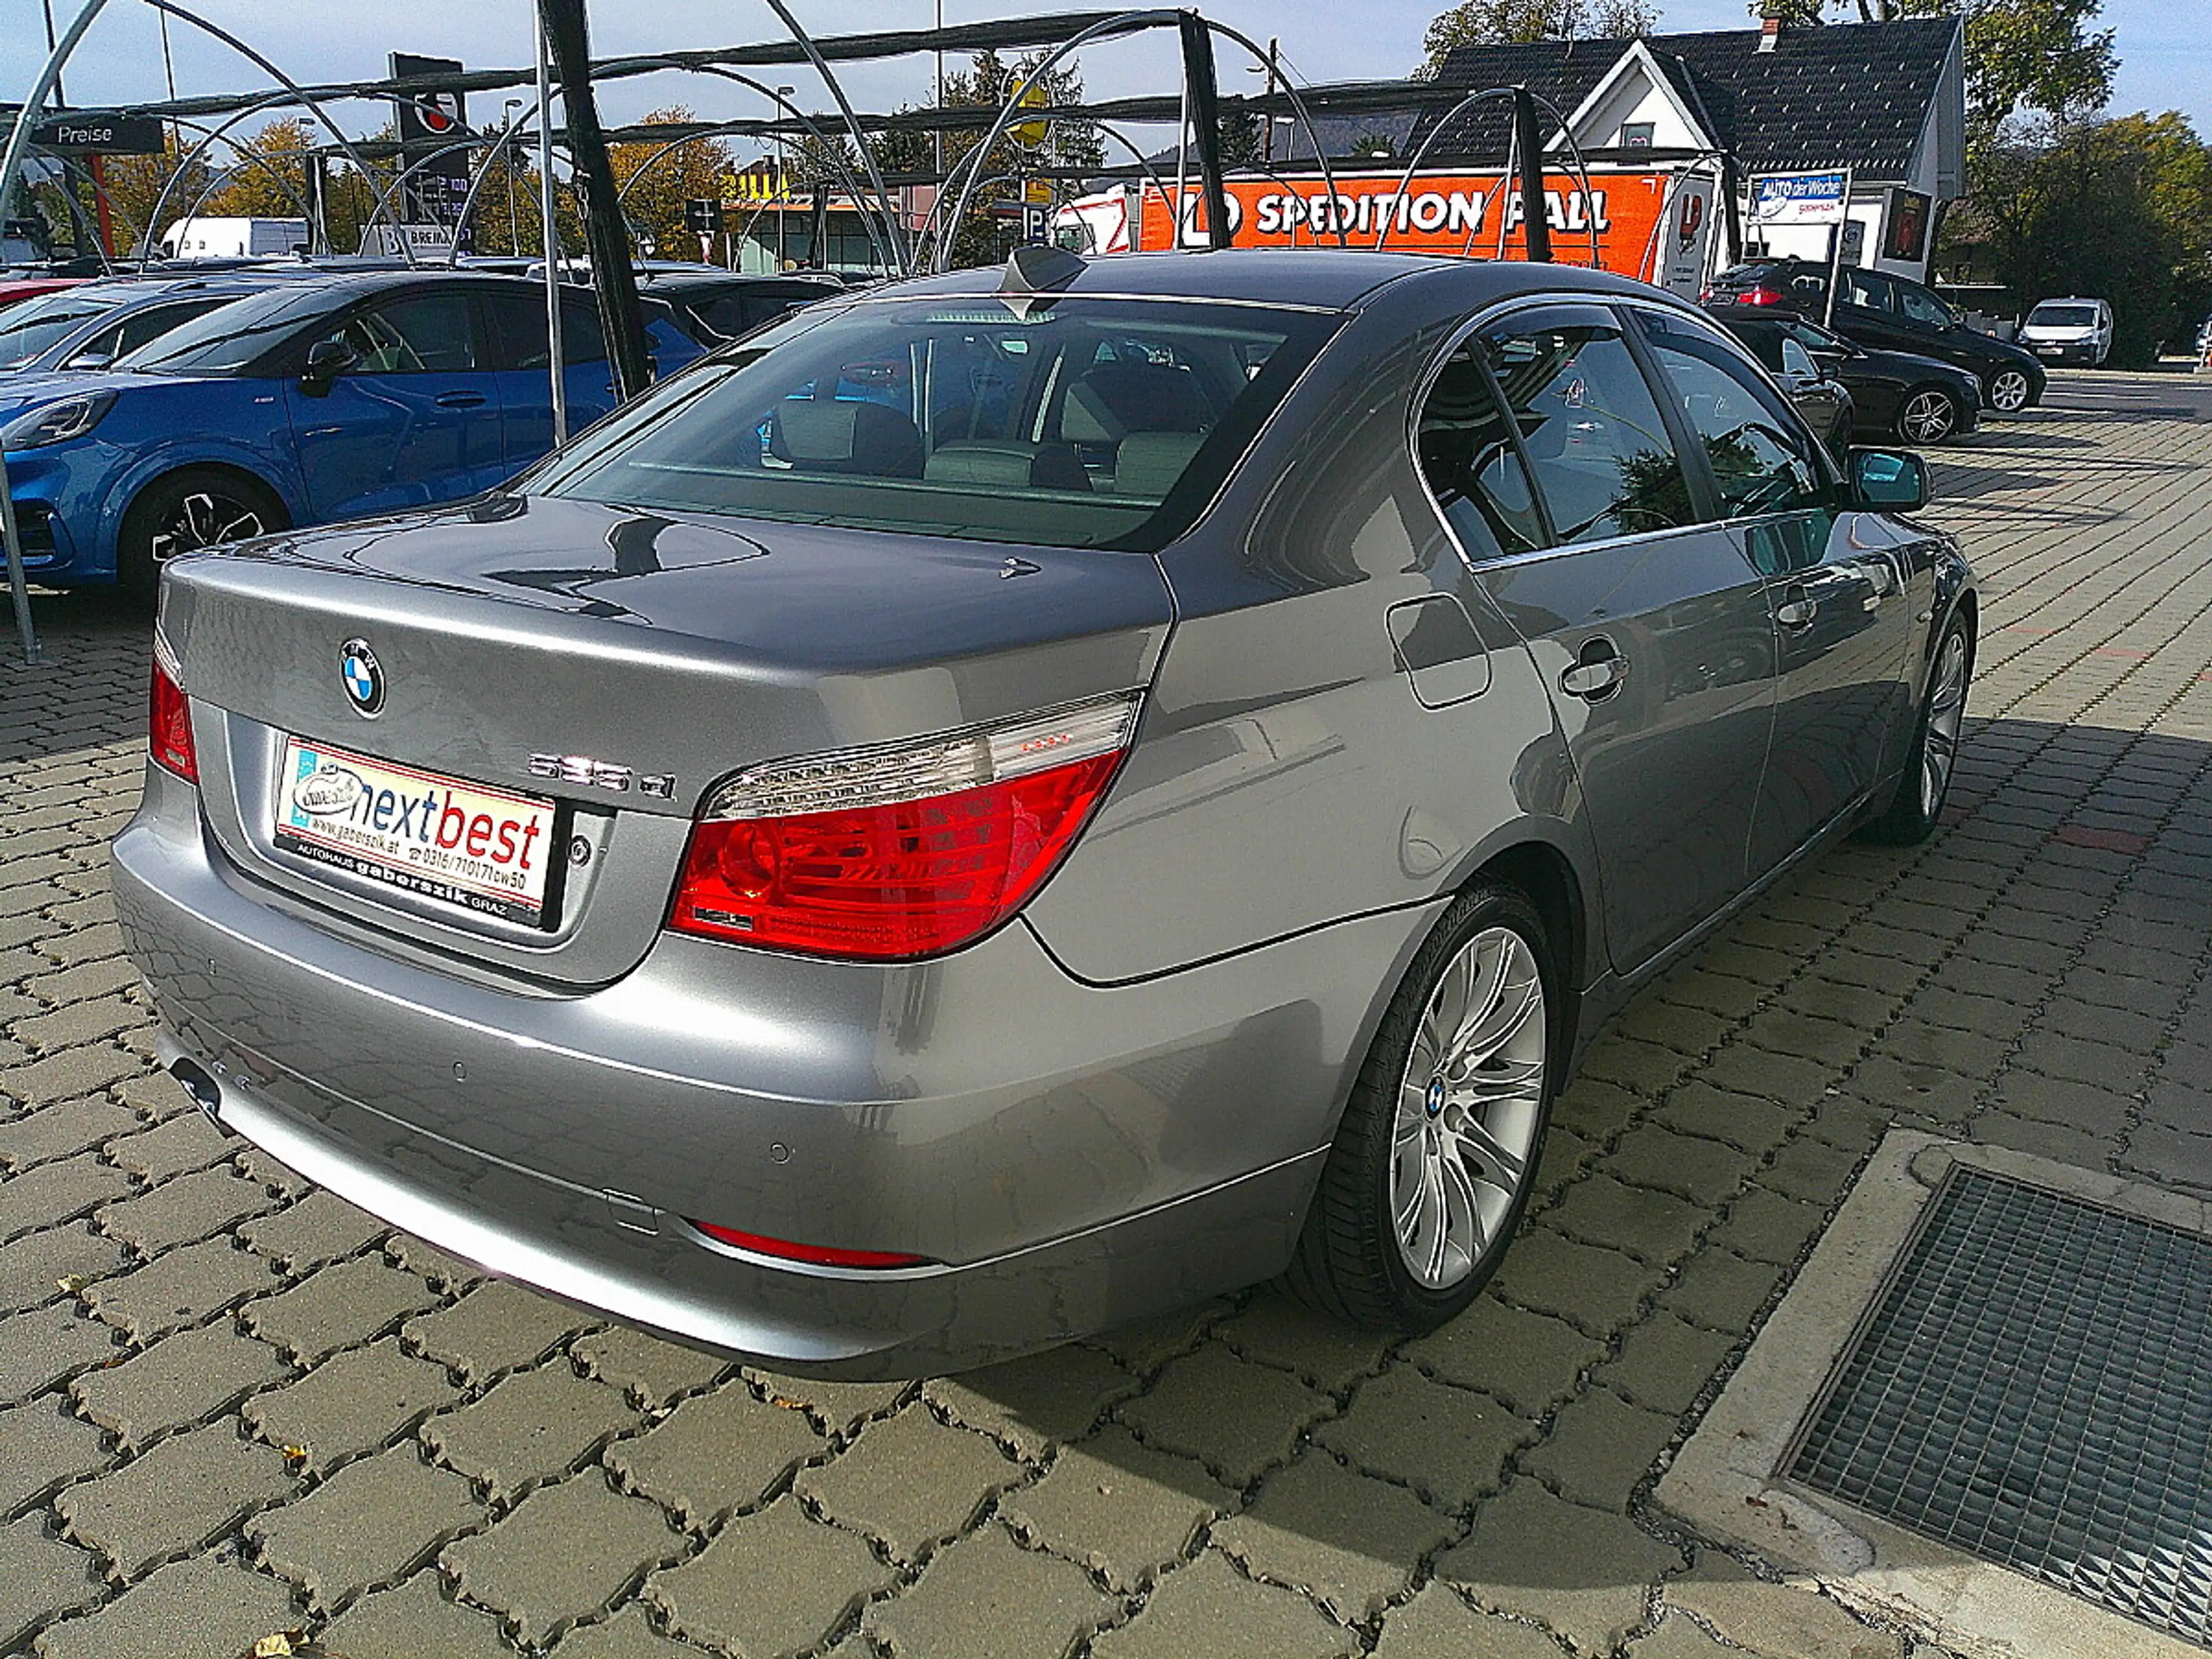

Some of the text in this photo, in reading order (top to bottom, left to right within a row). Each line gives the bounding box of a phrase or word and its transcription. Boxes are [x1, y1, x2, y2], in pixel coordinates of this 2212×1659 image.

[58, 125, 112, 143] Preise
[1257, 192, 1484, 234] SPEDITION
[349, 783, 541, 870] nextbest
[297, 844, 508, 915] AUTOHAUS gaberszik GRAZ
